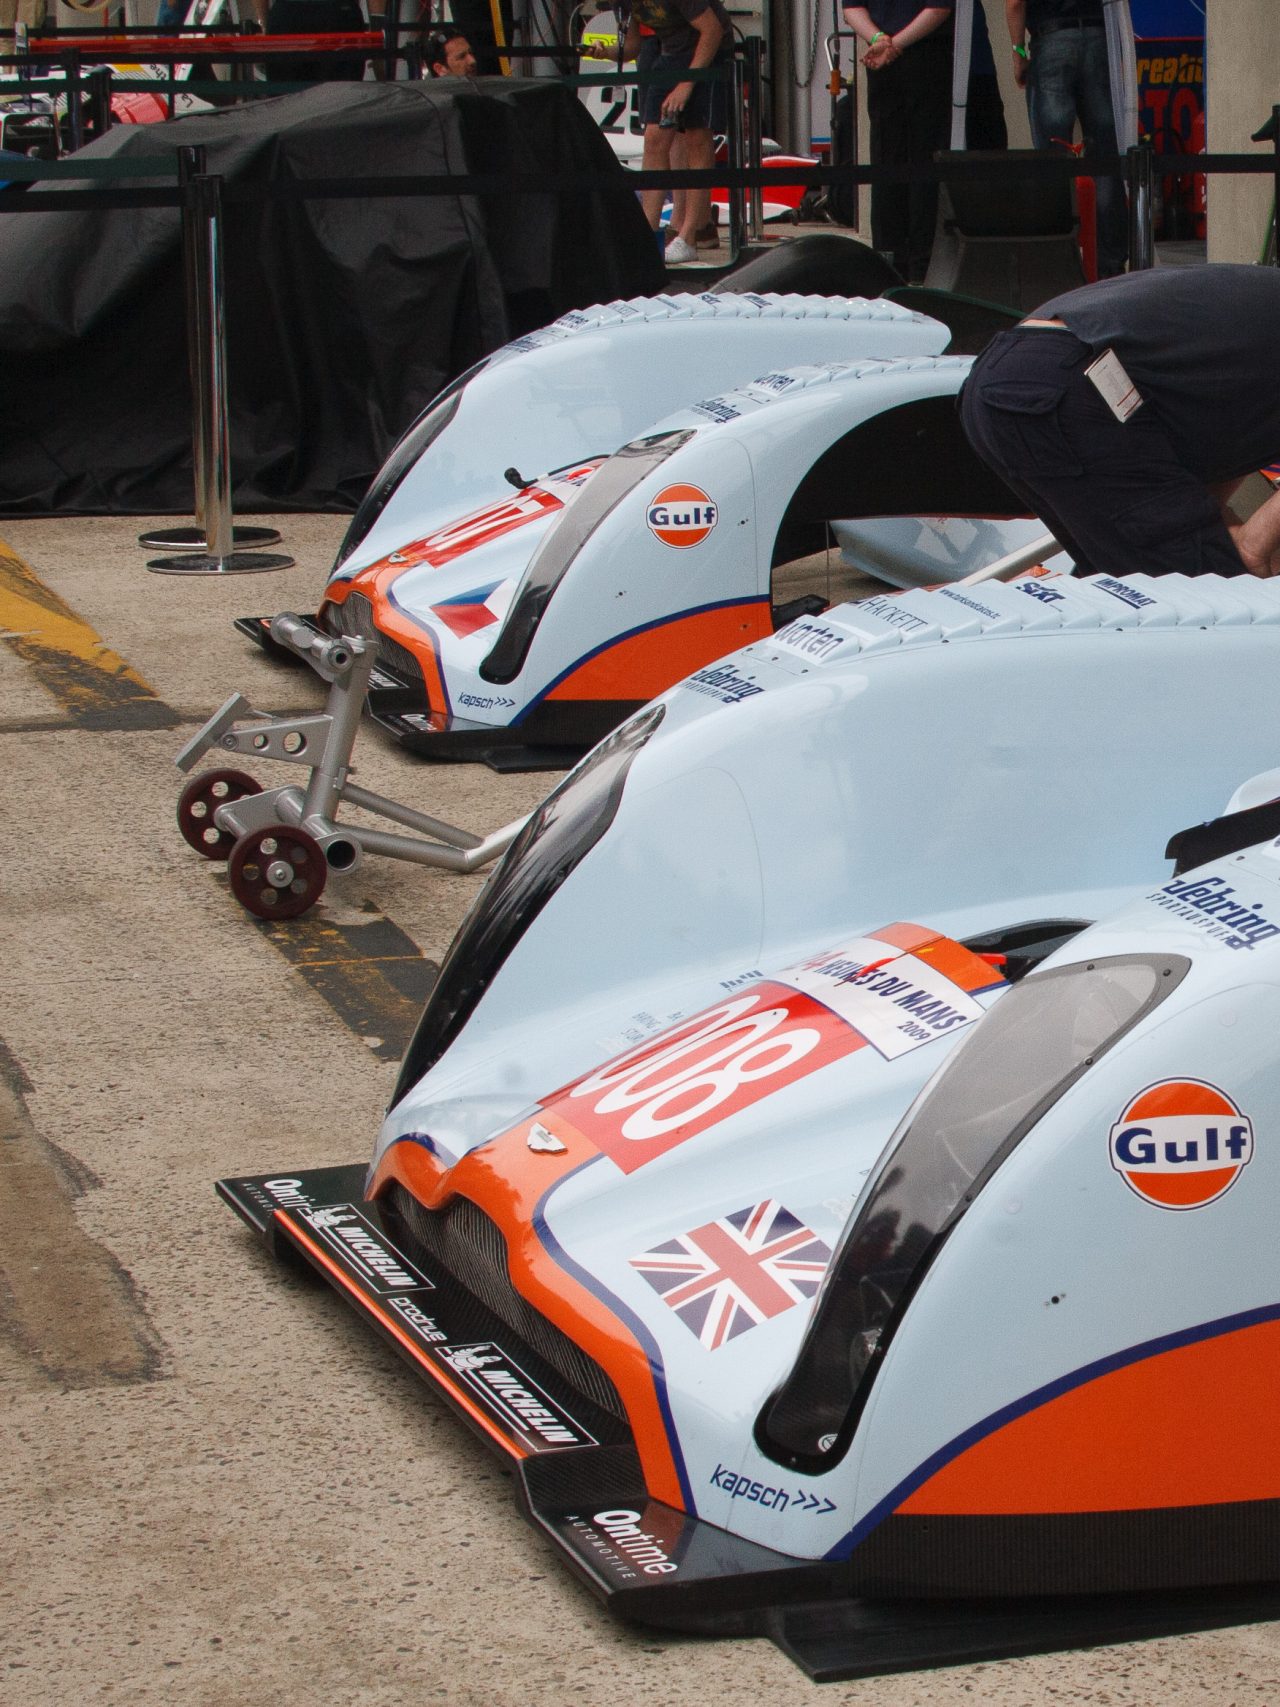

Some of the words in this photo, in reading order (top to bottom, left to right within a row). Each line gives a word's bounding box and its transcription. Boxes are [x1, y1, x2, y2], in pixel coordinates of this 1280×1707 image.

[649, 506, 716, 526] Gulf
[860, 598, 929, 632] HACKETT
[1094, 578, 1158, 607] IMPROMAT
[774, 622, 845, 659] worten
[458, 691, 495, 710] kapsch
[866, 970, 914, 997] DU
[892, 989, 968, 1031] MANS
[896, 1020, 932, 1041] 2009
[570, 995, 822, 1141] 008
[1115, 1125, 1248, 1165] Gulf
[334, 1226, 418, 1287] MICHELIN
[390, 1297, 448, 1343] prodrive
[478, 1370, 579, 1442] MICHELIN
[709, 1463, 791, 1512] kapsch
[566, 1515, 637, 1580] AUTOMOTIVE
[593, 1509, 678, 1575] Ontime
